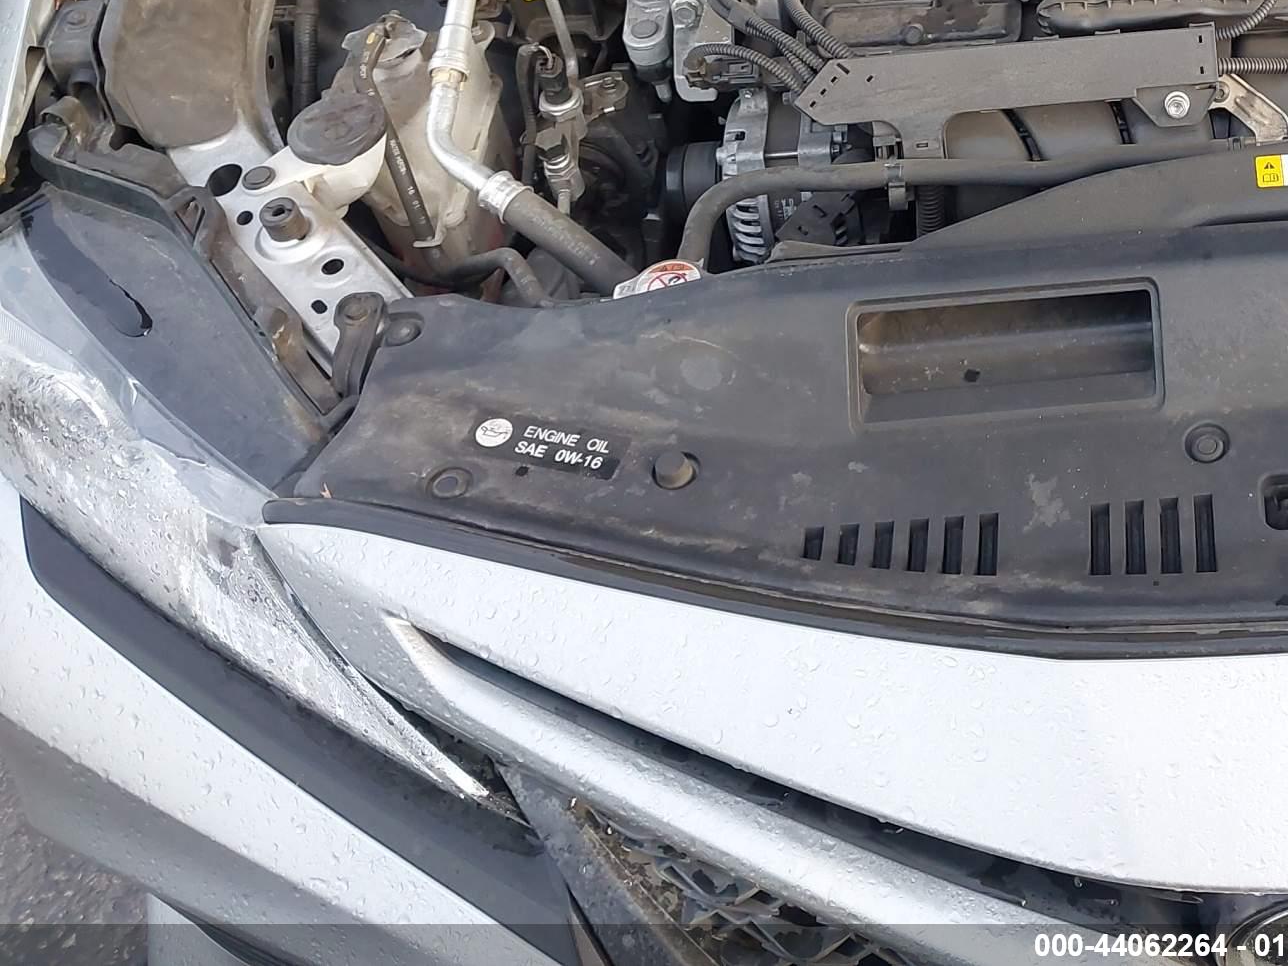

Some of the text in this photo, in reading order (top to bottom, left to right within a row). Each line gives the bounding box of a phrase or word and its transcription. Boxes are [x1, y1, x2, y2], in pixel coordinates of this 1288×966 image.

[524, 425, 610, 453] ENGINE OIL
[514, 441, 604, 470] SAE 0W-16
